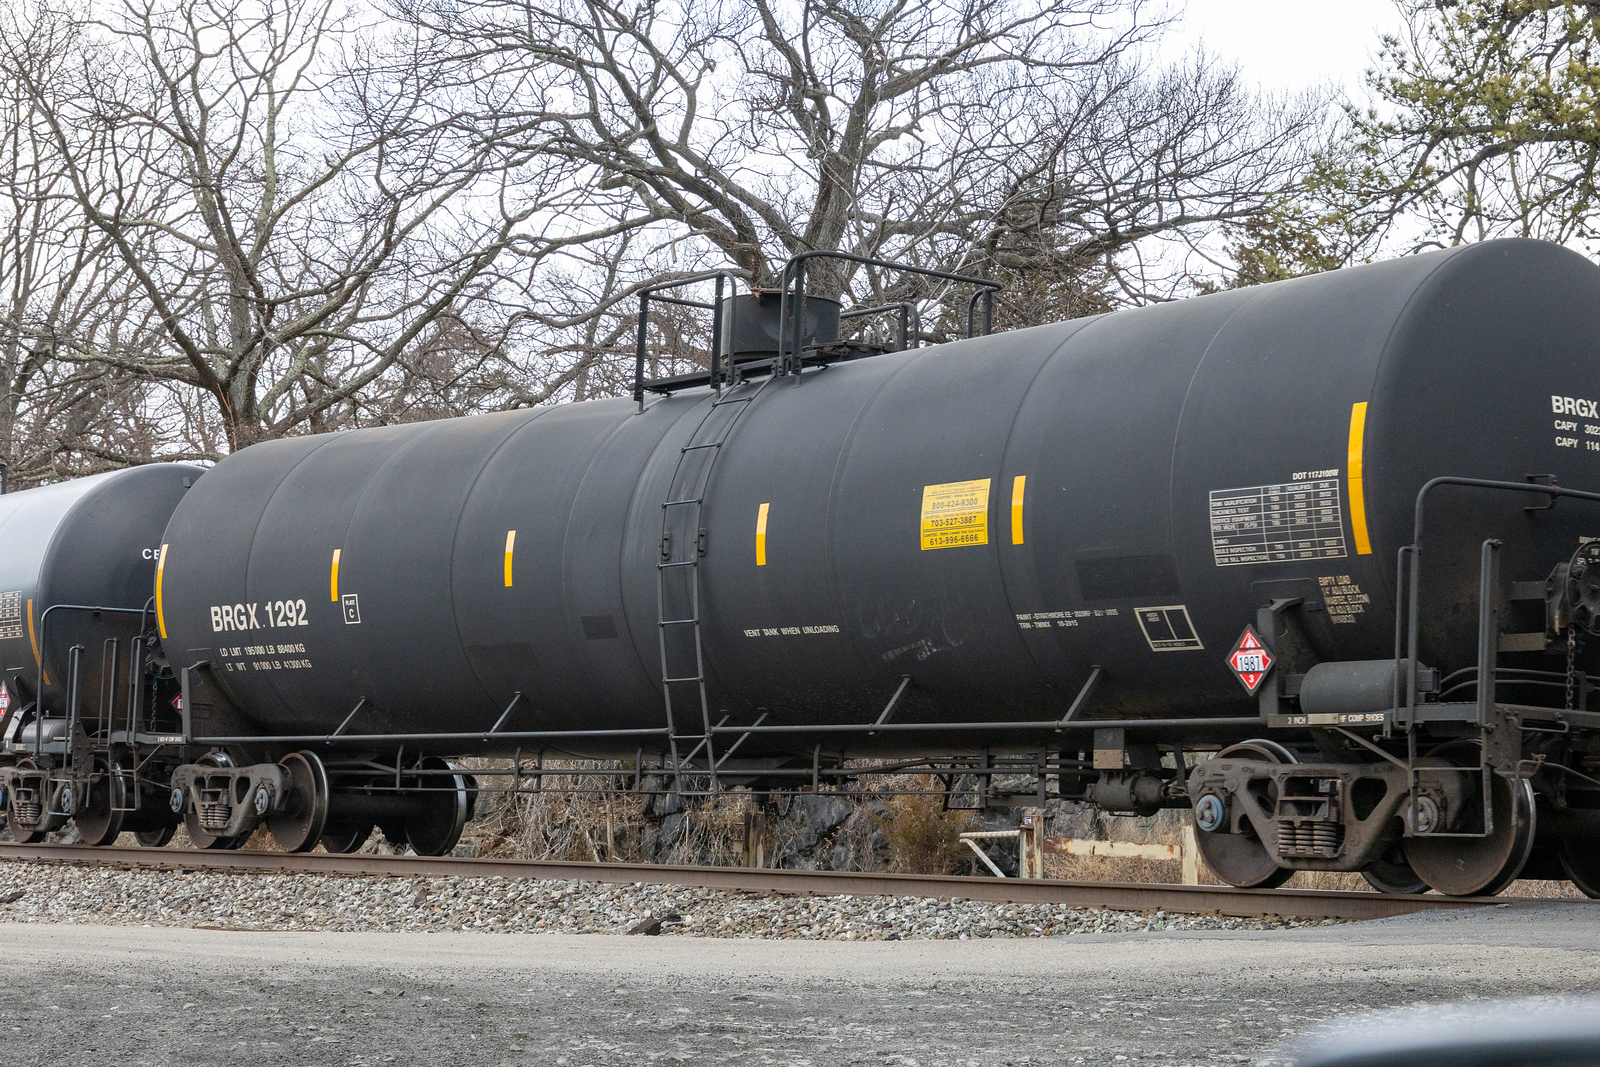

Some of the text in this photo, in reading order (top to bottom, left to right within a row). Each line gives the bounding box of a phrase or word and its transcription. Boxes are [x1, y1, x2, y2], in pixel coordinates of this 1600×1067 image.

[1551, 395, 1599, 419] BRGX
[1554, 420, 1578, 432] CAPY
[1555, 436, 1578, 448] CAPY
[1292, 472, 1307, 480] DOT
[931, 497, 979, 510] 800-424-9300
[930, 515, 977, 528] 703-527-3887
[929, 533, 979, 546] 613-996-6666
[1341, 584, 1361, 594] BLOCK
[348, 608, 355, 619] C
[1345, 603, 1366, 613] BLOCK
[210, 598, 309, 632] BRGX 1292
[743, 624, 840, 637] VENT TANK WHEN UNLOADING
[219, 647, 229, 657] LD
[230, 646, 243, 656] LMT
[244, 645, 266, 656] 195000
[265, 644, 276, 654] LB
[225, 662, 234, 672] LT
[235, 661, 247, 671] WT
[271, 660, 282, 670] LB
[1239, 655, 1260, 672] 1987
[1248, 674, 1255, 683] 3
[1287, 717, 1293, 725] 2
[1293, 716, 1307, 725] INCH
[1347, 714, 1364, 723] COMP
[1365, 713, 1385, 722] SHOES
